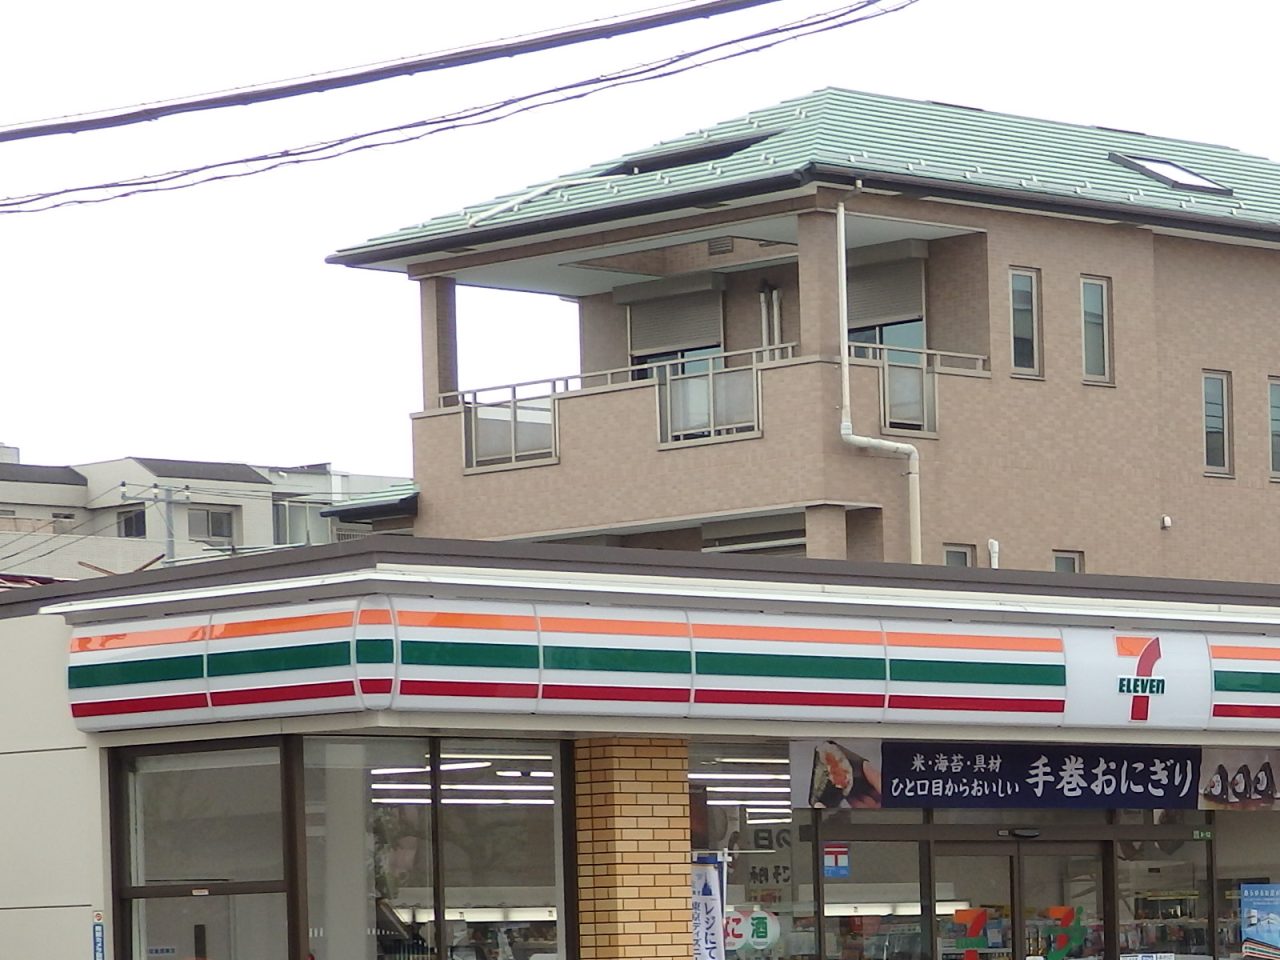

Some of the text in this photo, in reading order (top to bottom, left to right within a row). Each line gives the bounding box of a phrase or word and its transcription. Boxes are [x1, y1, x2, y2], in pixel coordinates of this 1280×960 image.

[1115, 635, 1162, 721] 7
[911, 753, 1003, 773] 米・海苔・具材
[891, 777, 1020, 799] ひと口目からおいしい
[1025, 756, 1194, 798] 手巻おにぎり
[750, 916, 768, 939] 酒
